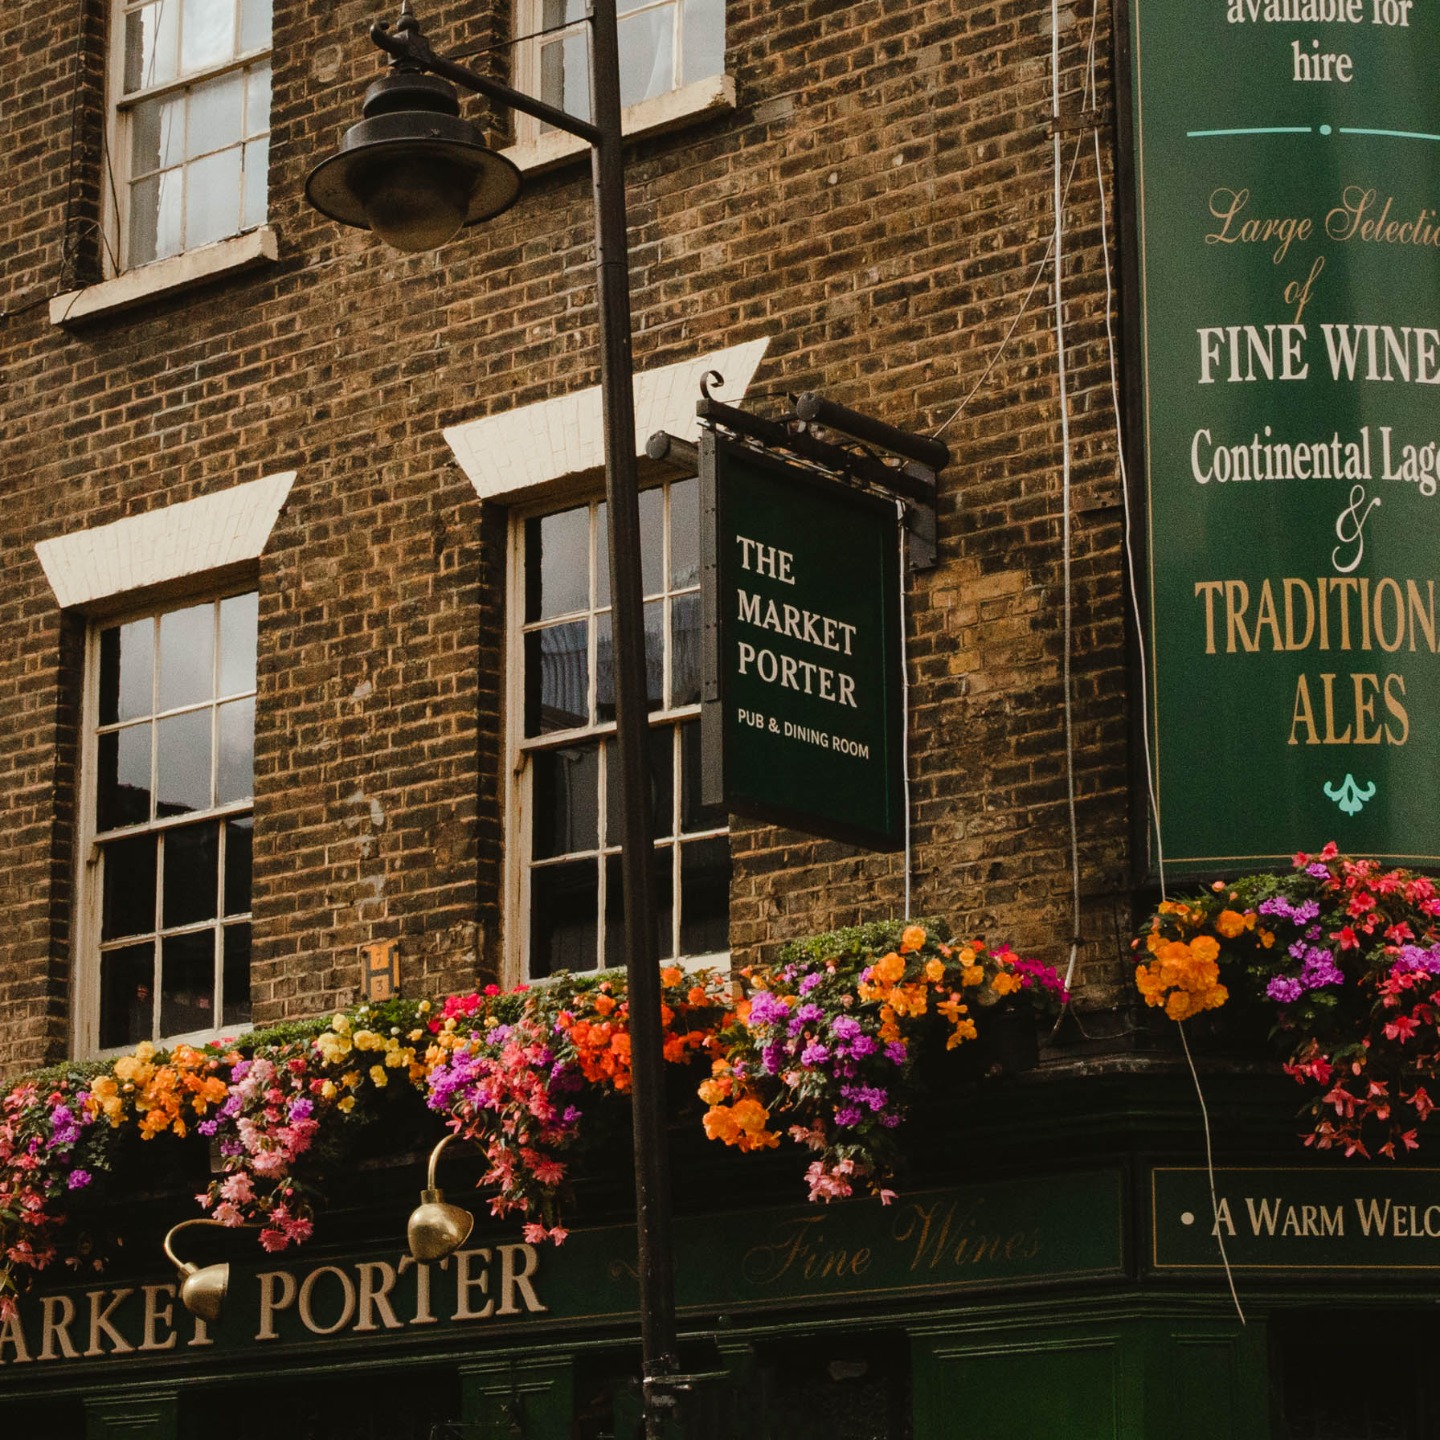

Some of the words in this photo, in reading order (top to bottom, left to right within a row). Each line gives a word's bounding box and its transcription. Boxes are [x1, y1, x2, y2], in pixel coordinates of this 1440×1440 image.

[1291, 39, 1353, 83] hire
[1205, 186, 1314, 264] Large
[1283, 256, 1325, 326] of
[1197, 324, 1308, 384] FINE
[1191, 426, 1370, 485] Continental
[736, 534, 795, 585] THE
[1332, 484, 1381, 572] &
[737, 589, 856, 656] MARKET
[738, 641, 858, 708] PORTER
[738, 708, 764, 729] PUB
[768, 717, 781, 734] &
[784, 721, 829, 749] DINING
[832, 736, 869, 760] ROOM
[1288, 673, 1409, 747] ALES
[741, 1213, 872, 1285] Fine
[891, 1196, 1041, 1272] Wines
[1210, 1197, 1237, 1236] A
[1245, 1197, 1344, 1236] WARM
[254, 1242, 549, 1341] PORTER
